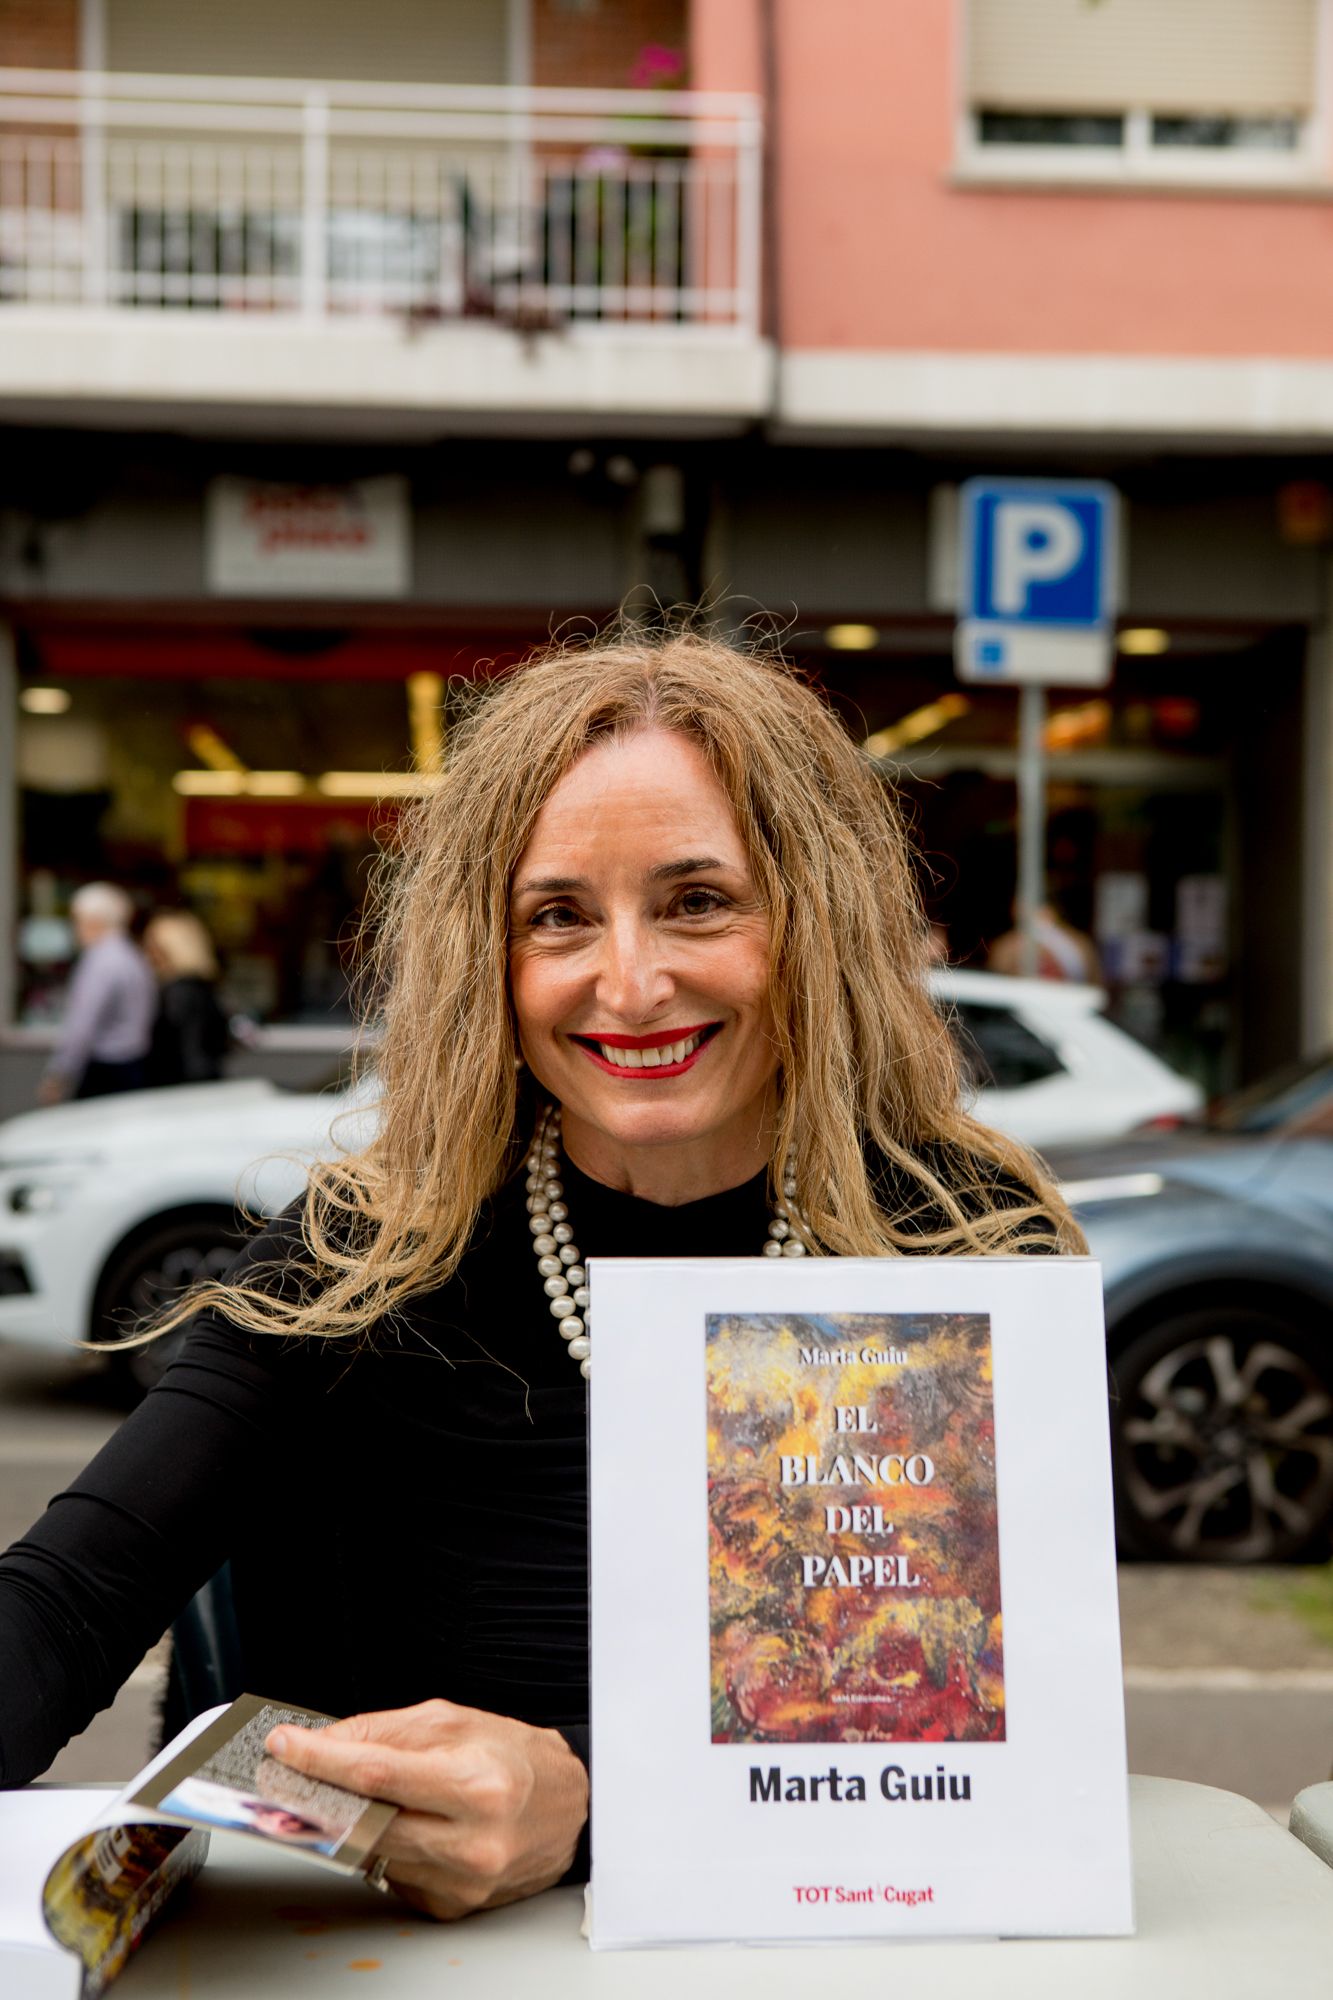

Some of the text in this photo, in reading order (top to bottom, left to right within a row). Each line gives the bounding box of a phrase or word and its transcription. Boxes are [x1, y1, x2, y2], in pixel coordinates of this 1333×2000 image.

[993, 502, 1083, 614] P
[799, 1346, 908, 1364] Marta Guiu
[834, 1405, 878, 1433] EL
[779, 1454, 935, 1486] BLANCO
[825, 1505, 893, 1533] DEL
[802, 1555, 920, 1587] PAPEL
[750, 1764, 972, 1802] Marta Guiu
[793, 1886, 934, 1907] TOT Sant Cugat
